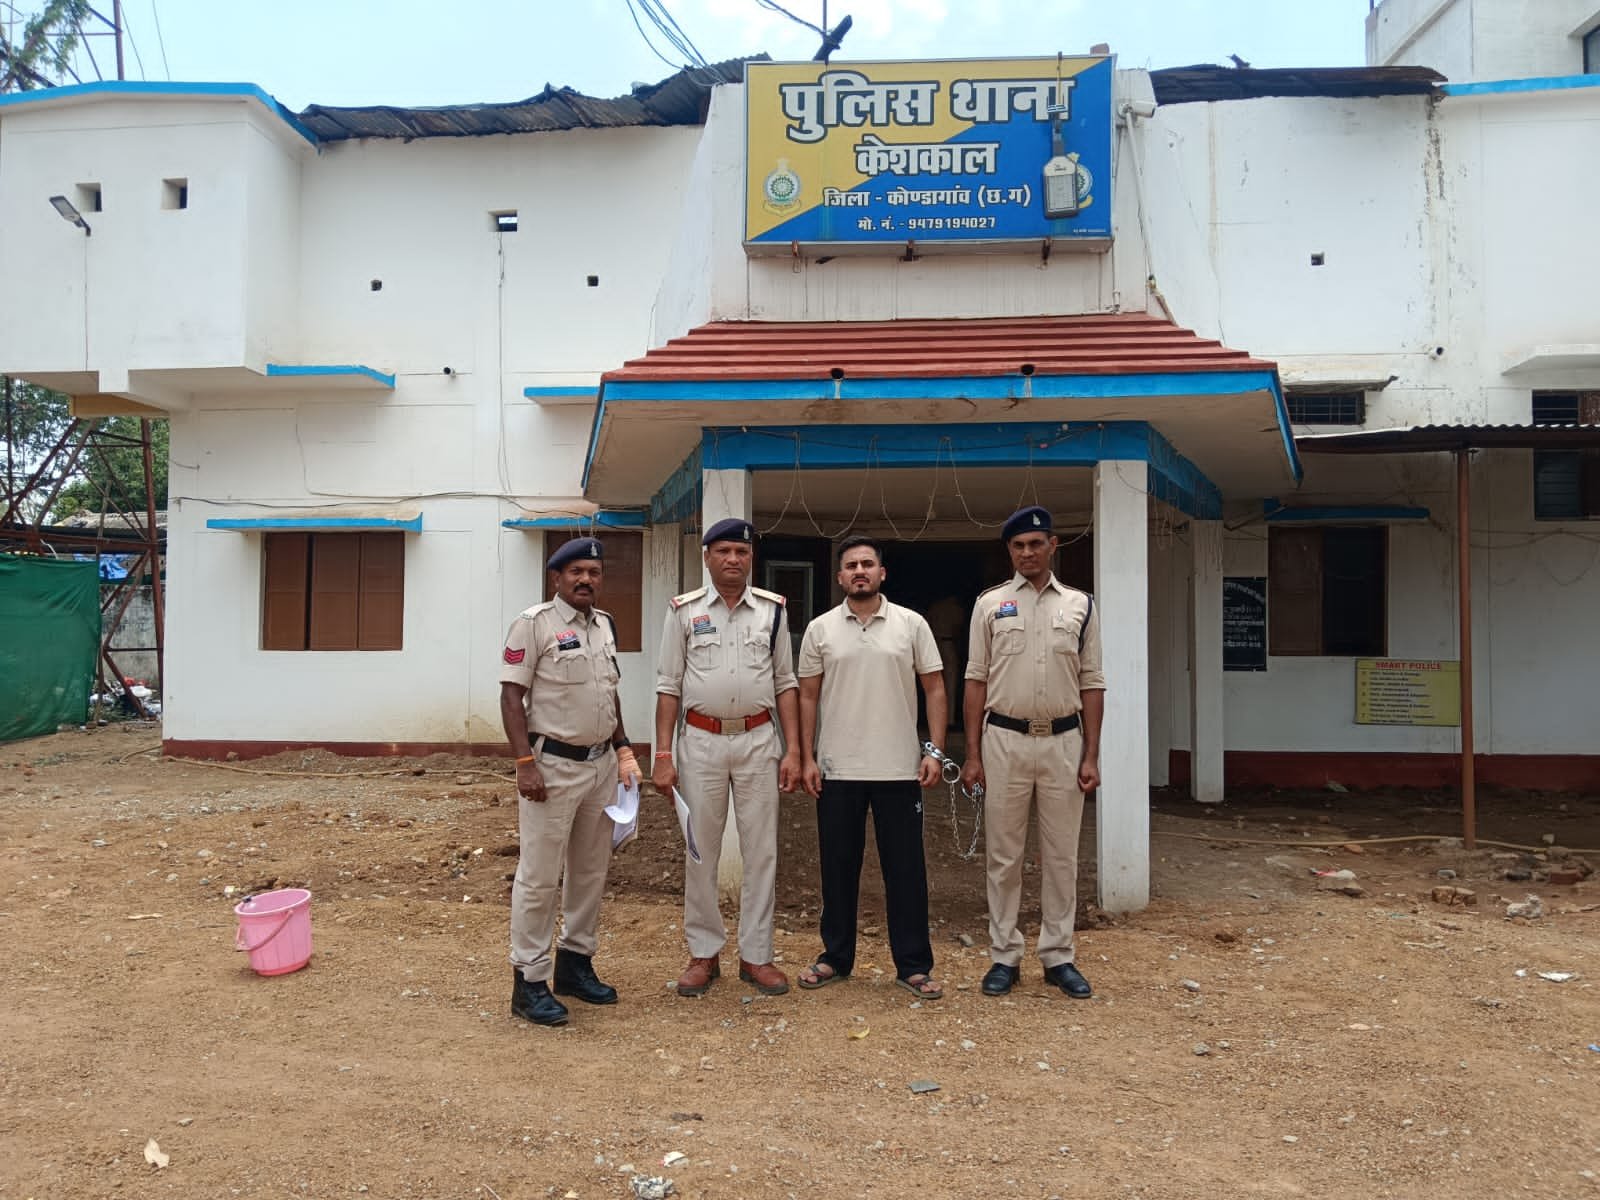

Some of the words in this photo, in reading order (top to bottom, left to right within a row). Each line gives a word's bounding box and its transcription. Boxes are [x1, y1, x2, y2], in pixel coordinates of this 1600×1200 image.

[779, 70, 939, 142] पुलिस
[950, 77, 1076, 124] थाना
[854, 134, 1000, 176] केशकाल
[823, 186, 870, 207] जिला
[886, 185, 971, 206] कोण्डागांव
[908, 217, 996, 230] 9479194027
